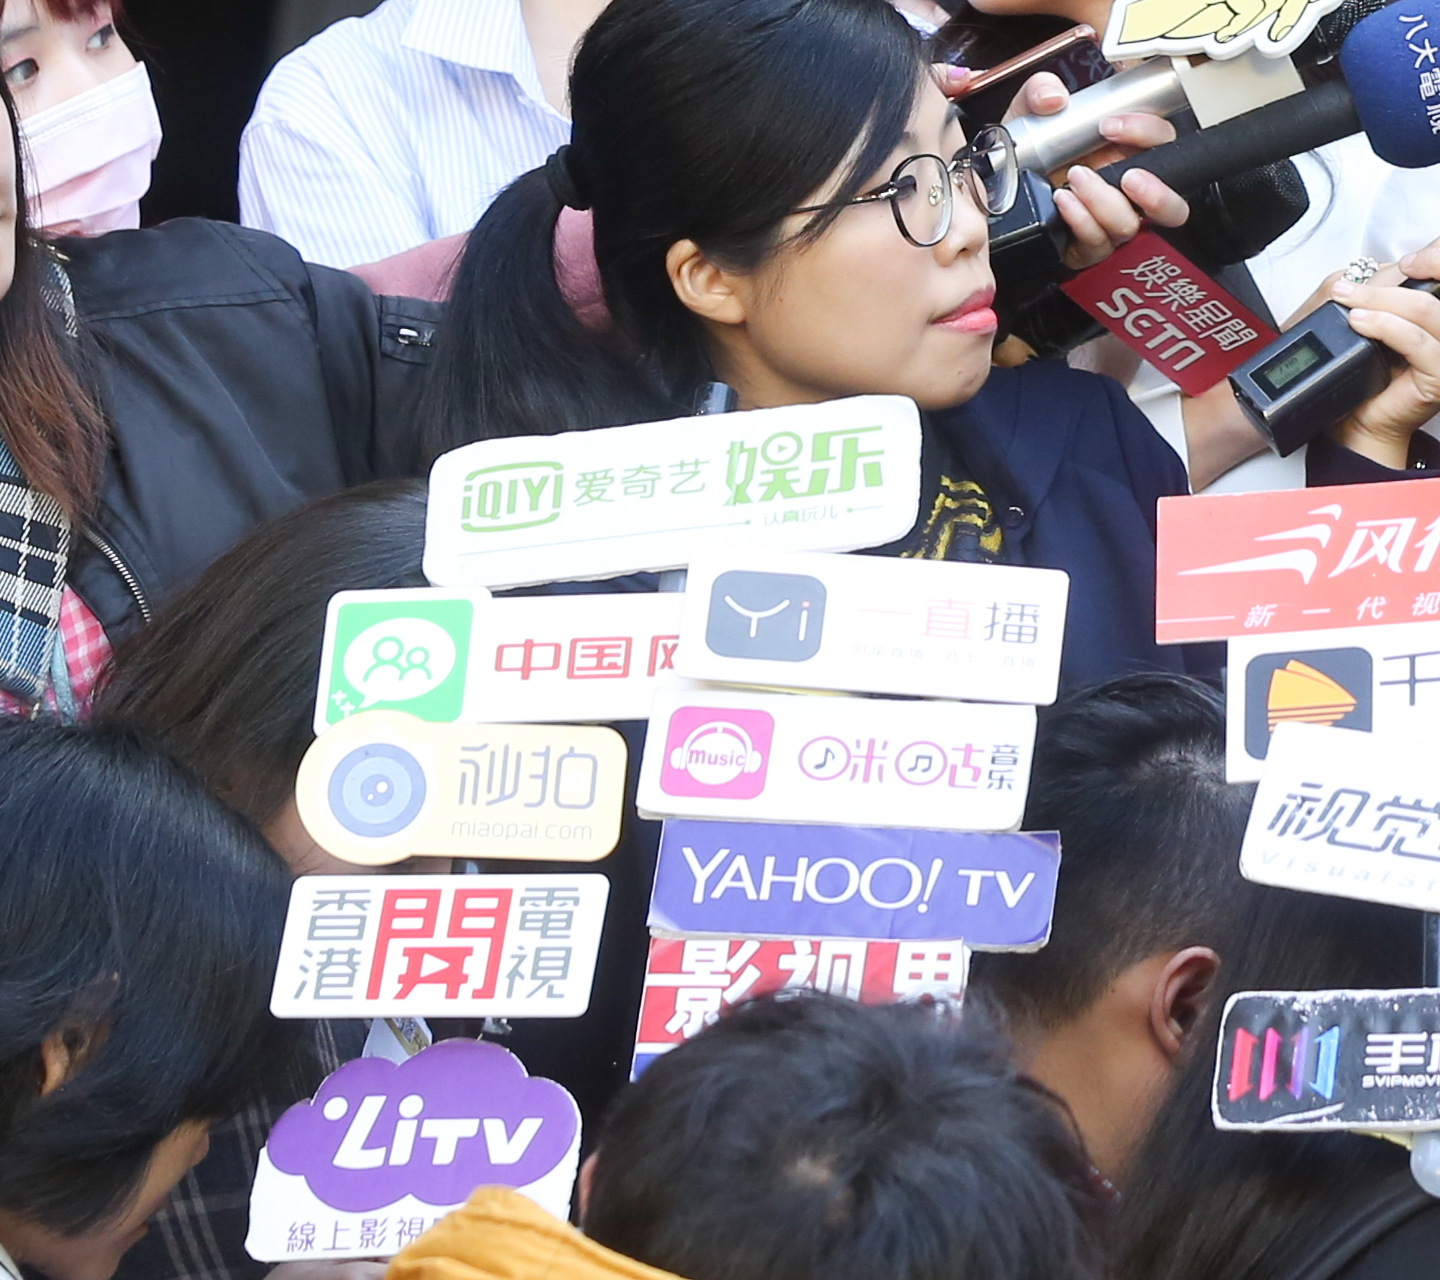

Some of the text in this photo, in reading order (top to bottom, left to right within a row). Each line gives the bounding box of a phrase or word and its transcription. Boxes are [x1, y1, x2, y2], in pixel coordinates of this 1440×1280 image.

[1120, 255, 1259, 352] 娛樂星聞
[573, 457, 711, 507] 爱奇艺
[723, 425, 885, 507] 娱乐
[858, 598, 1041, 645] 一直播
[688, 749, 745, 767] music
[451, 819, 592, 840] miaopai.com
[681, 847, 1035, 914] YAHOO! TV
[287, 1216, 444, 1253] 線上影視
